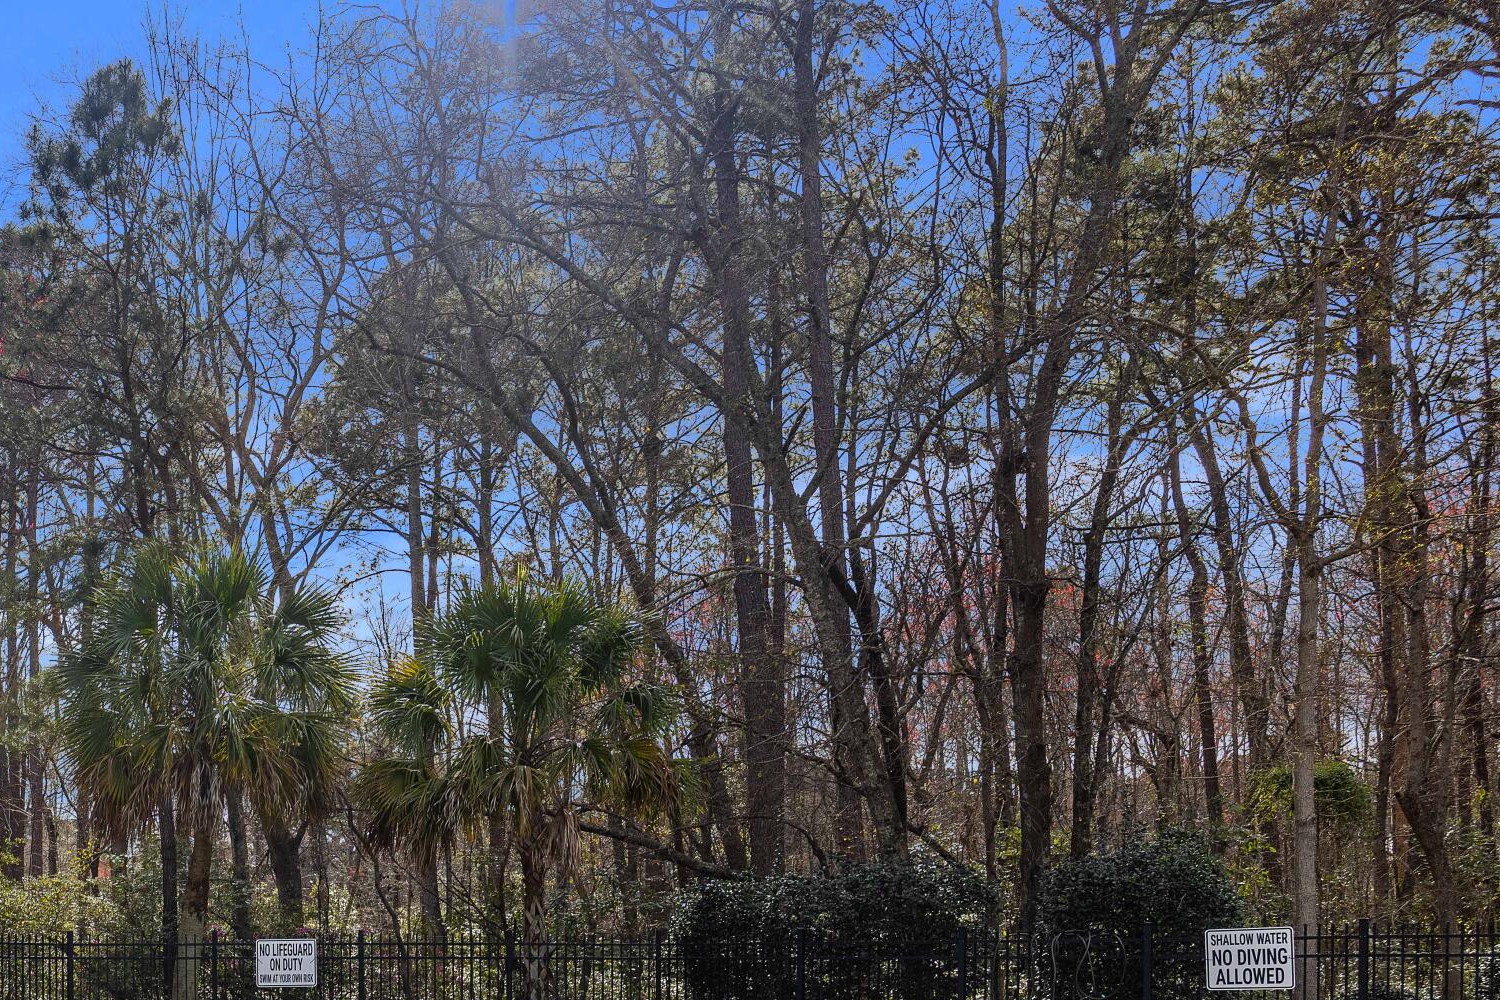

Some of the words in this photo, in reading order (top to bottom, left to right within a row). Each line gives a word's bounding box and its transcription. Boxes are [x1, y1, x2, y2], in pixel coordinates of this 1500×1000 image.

[1210, 933, 1254, 946] SHALLOW
[1256, 932, 1288, 945] WATER
[260, 943, 270, 957] NO
[272, 943, 313, 957] LIFEGUARD
[1212, 949, 1233, 966] NO
[1237, 948, 1288, 966] DIVING
[270, 958, 280, 971] ON
[283, 958, 303, 971] DUTY
[260, 974, 271, 983] SWIM
[273, 974, 278, 983] AT
[279, 974, 291, 983] YOUR
[292, 974, 303, 983] OWN
[1216, 967, 1285, 985] ALLOWED
